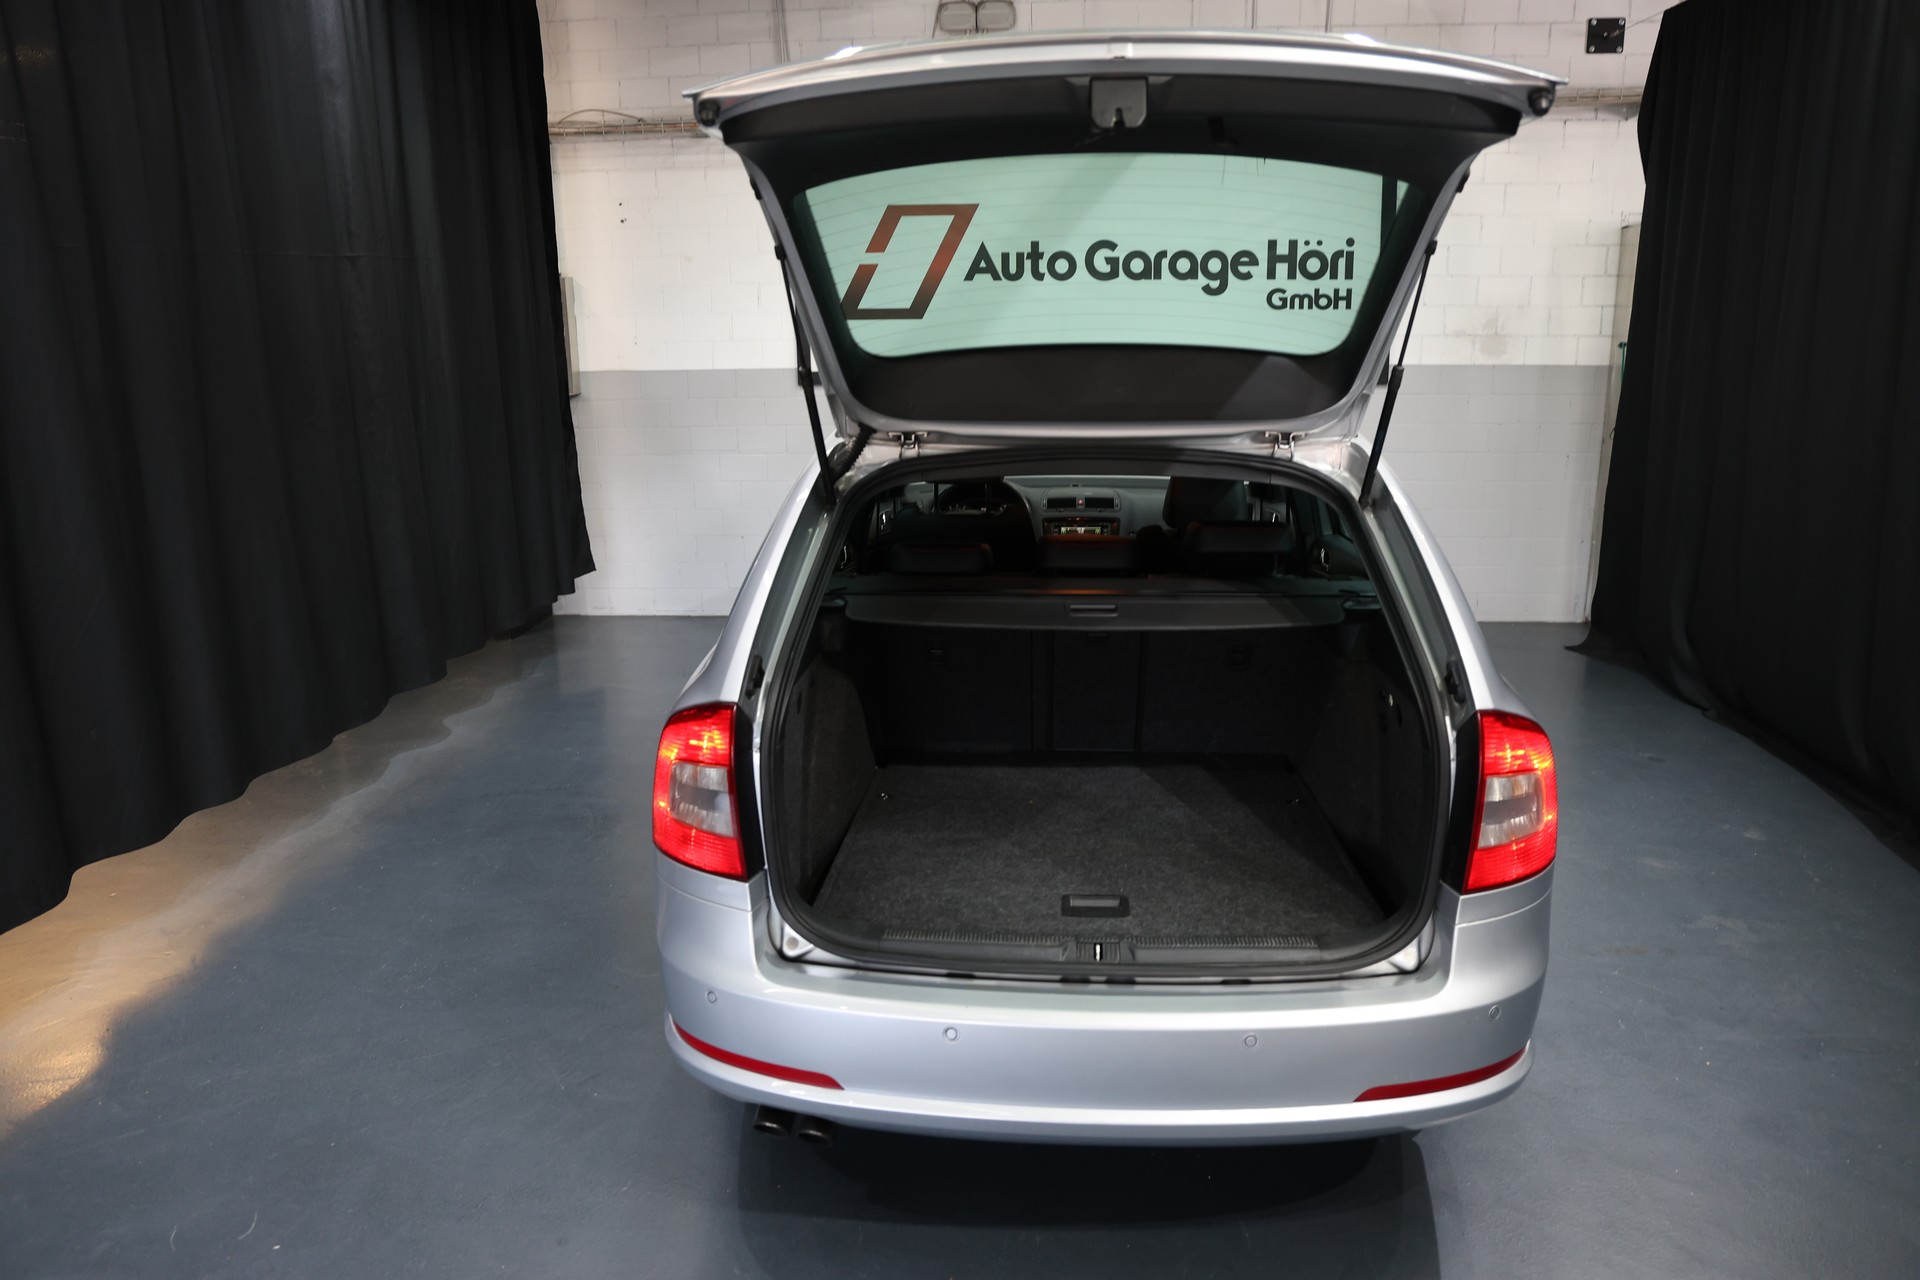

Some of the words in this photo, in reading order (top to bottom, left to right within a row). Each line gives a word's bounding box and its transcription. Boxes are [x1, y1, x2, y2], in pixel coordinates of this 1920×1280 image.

[963, 240, 1078, 282] Auto
[1084, 238, 1260, 297] Garage
[1266, 236, 1356, 281] Höri
[1266, 287, 1353, 311] GmbH
